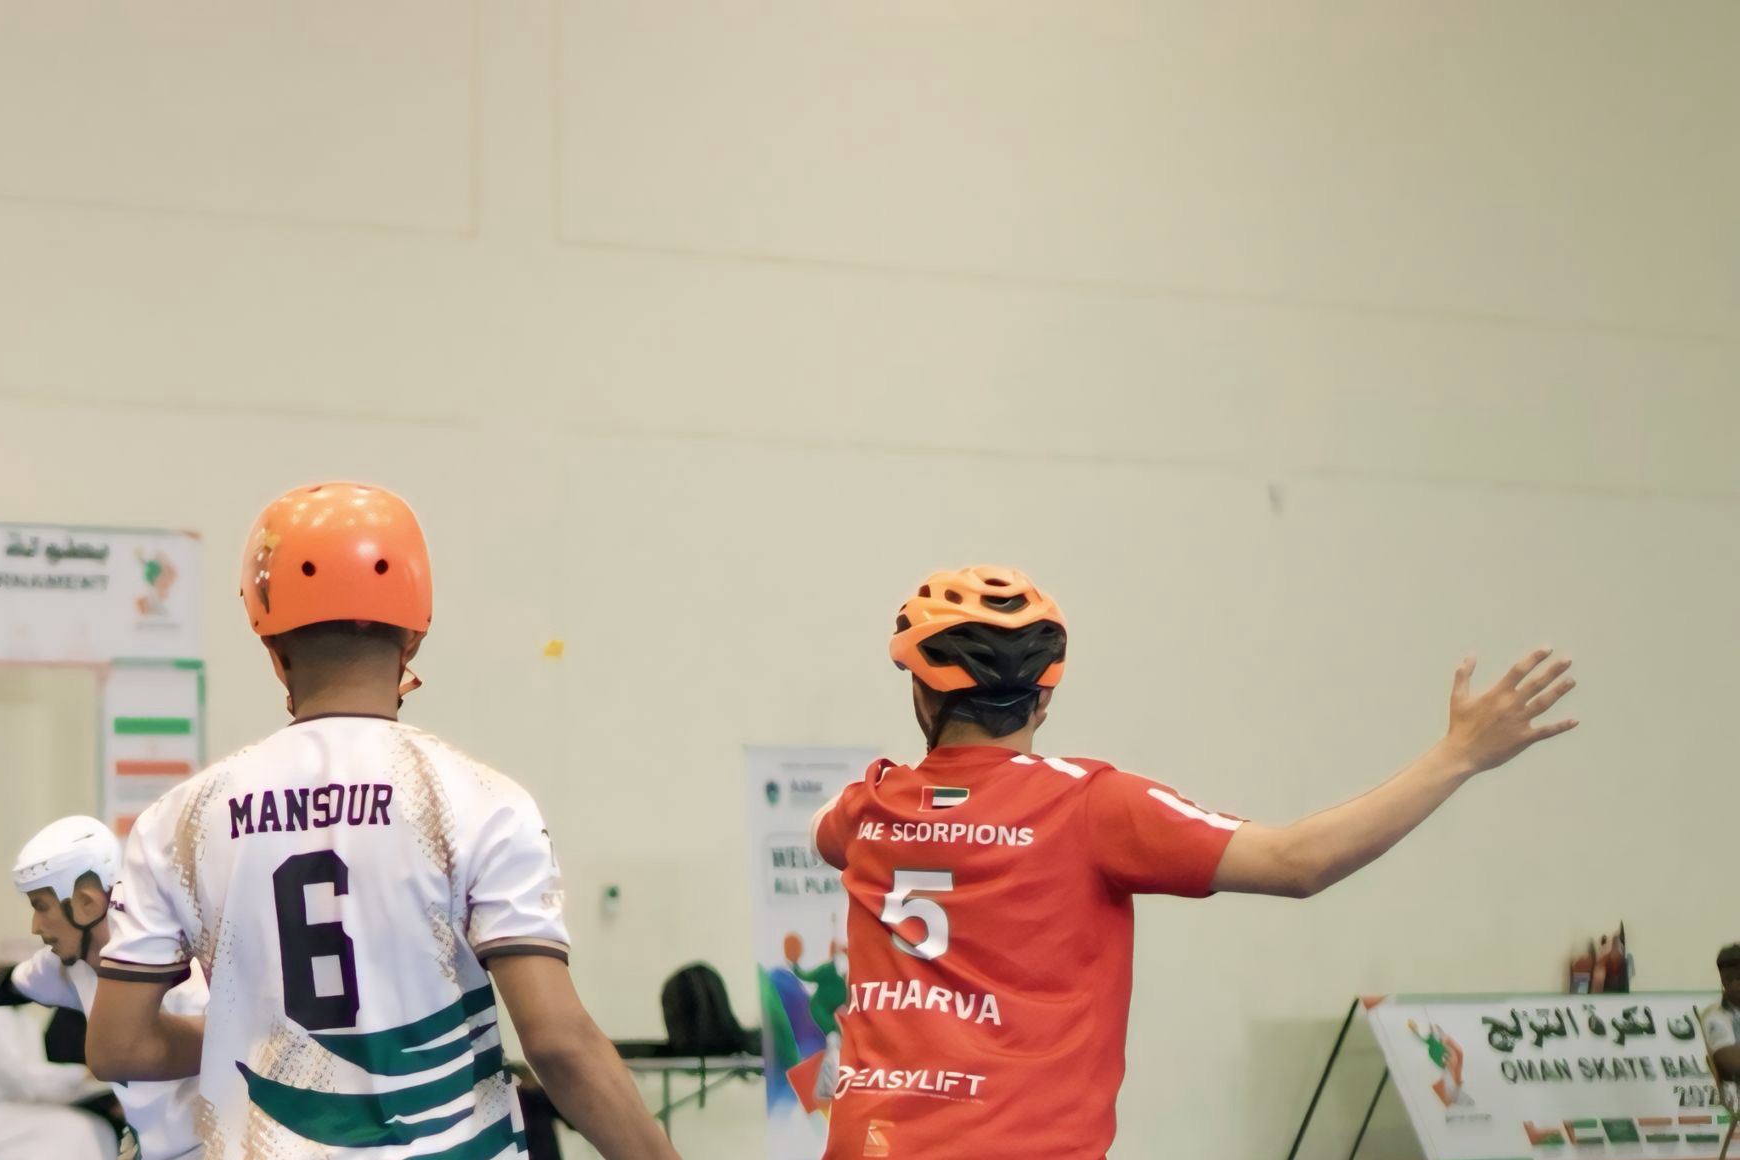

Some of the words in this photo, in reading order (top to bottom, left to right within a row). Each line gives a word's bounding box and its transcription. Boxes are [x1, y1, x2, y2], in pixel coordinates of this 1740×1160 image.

[5, 530, 110, 565] بطولة
[228, 783, 394, 840] MANSOUR
[890, 822, 1035, 847] SCORPIONS
[880, 868, 955, 961] 5
[272, 848, 360, 1032] 6
[848, 978, 1002, 1026] ATHARVA
[1581, 1003, 1657, 1046] لكرة
[850, 1068, 988, 1096] EASYLIFT
[1501, 1056, 1573, 1084] OMAN
[1577, 1056, 1657, 1082] SKATE
[1660, 1054, 1713, 1079] BAL
[1673, 1084, 1718, 1107] 202
